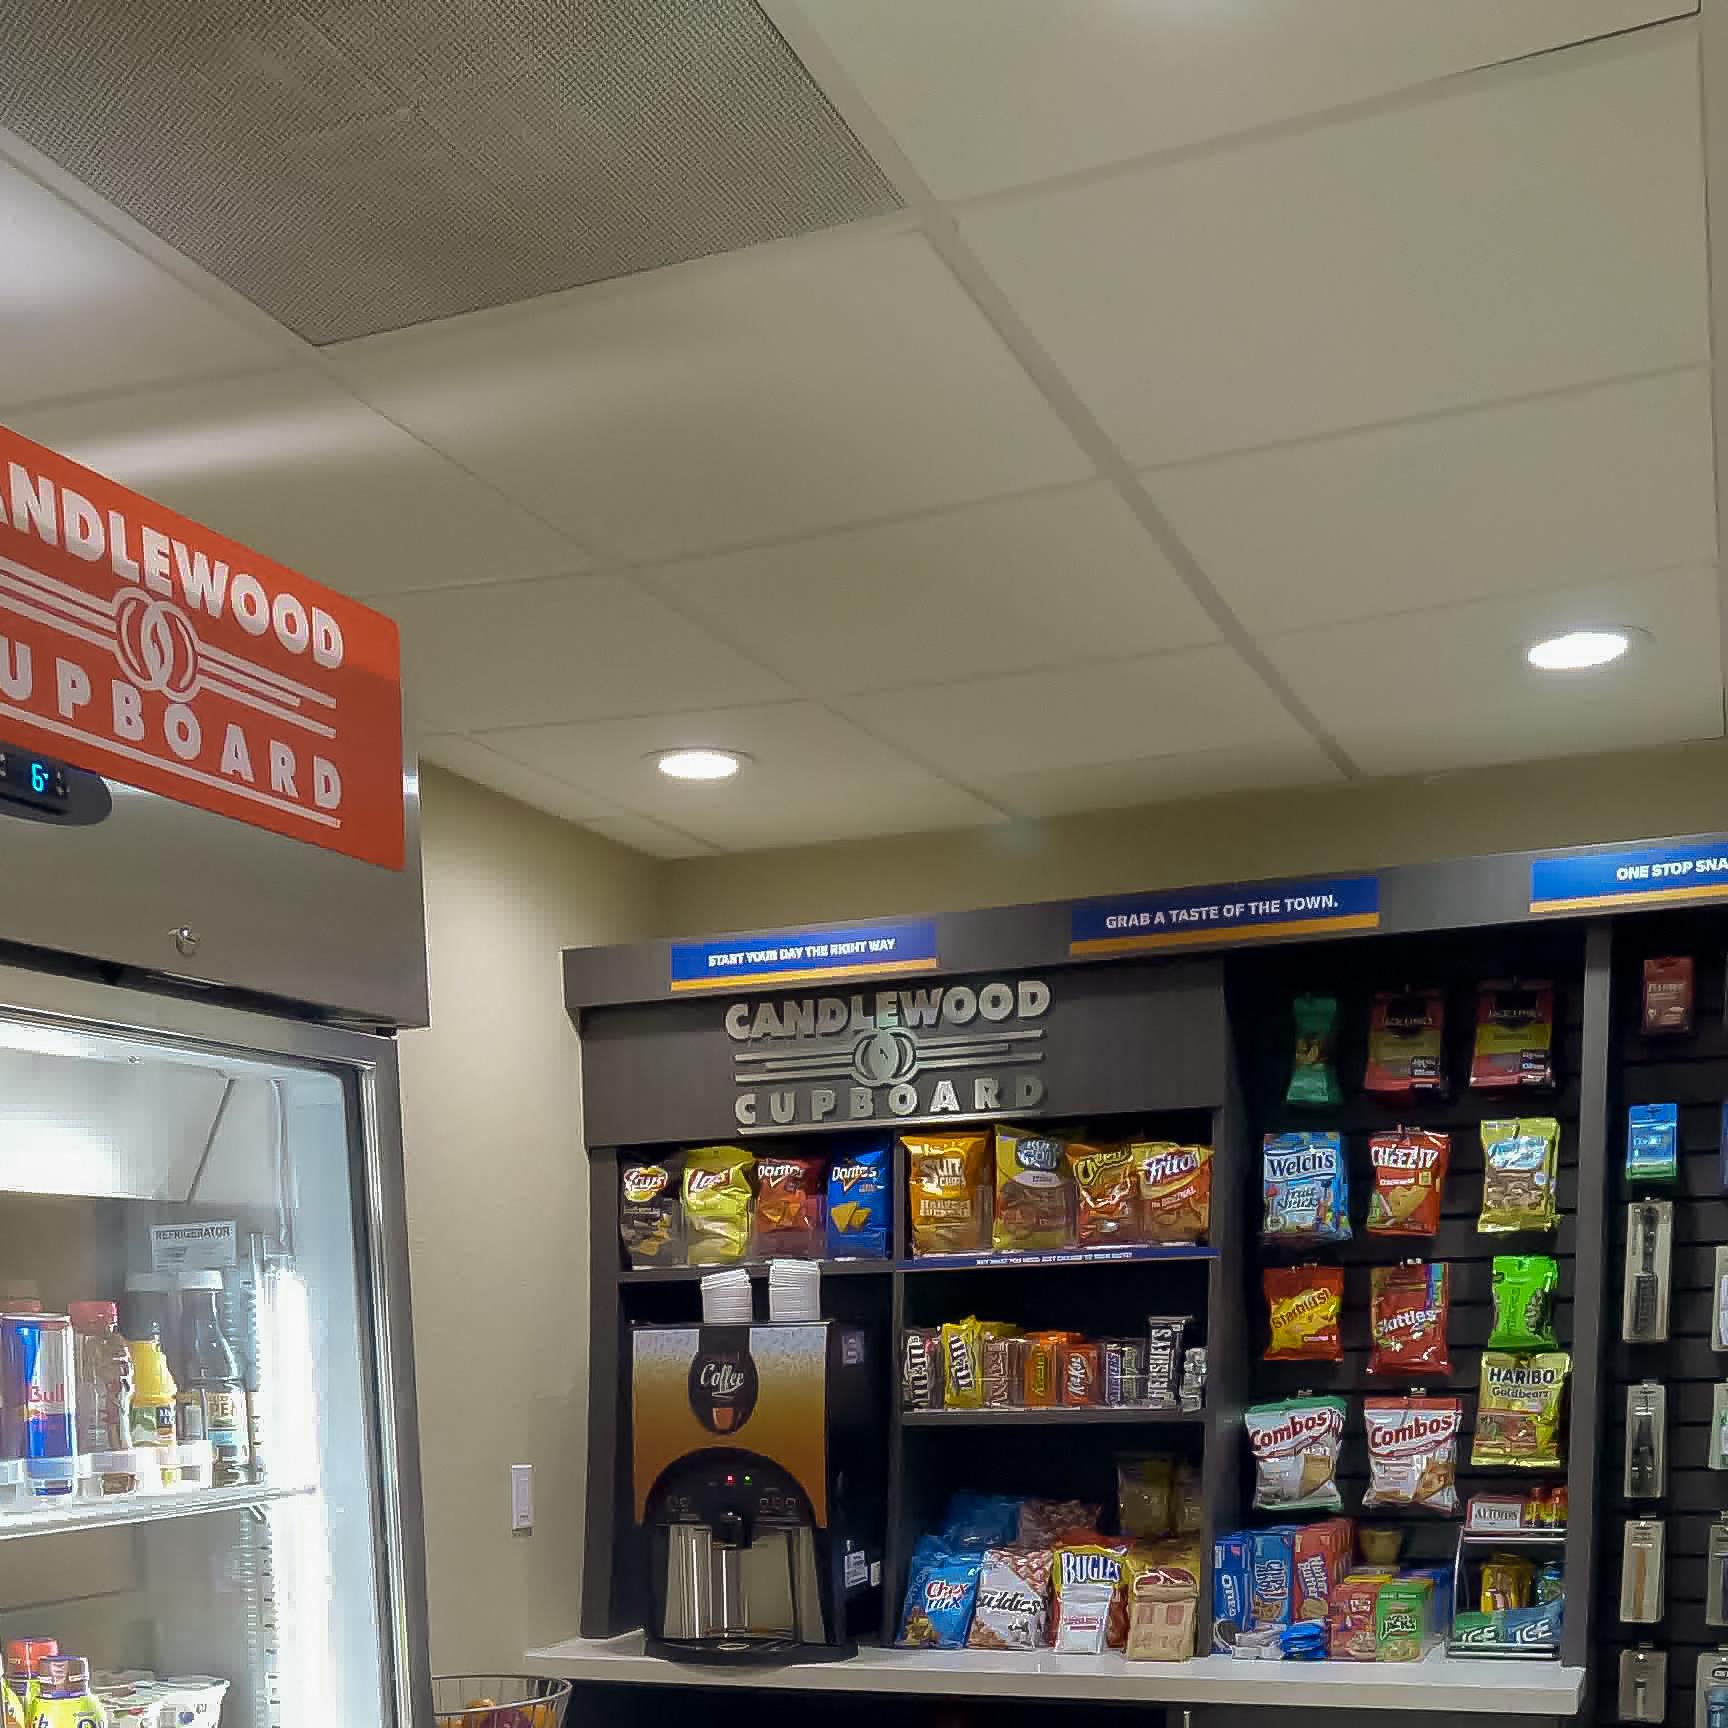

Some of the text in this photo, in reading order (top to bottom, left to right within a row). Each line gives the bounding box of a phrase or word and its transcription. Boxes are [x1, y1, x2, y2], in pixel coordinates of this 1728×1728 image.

[1616, 866, 1649, 881] ONE
[1652, 861, 1693, 878] STOP
[1106, 894, 1338, 929] GRAB A TASTE OF THE TOWN.
[708, 953, 744, 968] START
[746, 950, 777, 964] YOUR
[779, 948, 802, 961] DAY
[804, 946, 829, 959] THE
[725, 980, 1050, 1040] CANDLEWOOD
[735, 1077, 1043, 1124] CUPBOARD
[1268, 1151, 1336, 1178] Welch's
[700, 1362, 744, 1396] Coffee
[1489, 1367, 1555, 1385] HARIBO
[1492, 1387, 1552, 1401] Goldbears
[1249, 1409, 1329, 1450] Combos
[1370, 1414, 1453, 1449] Combos
[1062, 1552, 1122, 1585] BUGLES
[1512, 1619, 1553, 1644] ICE
